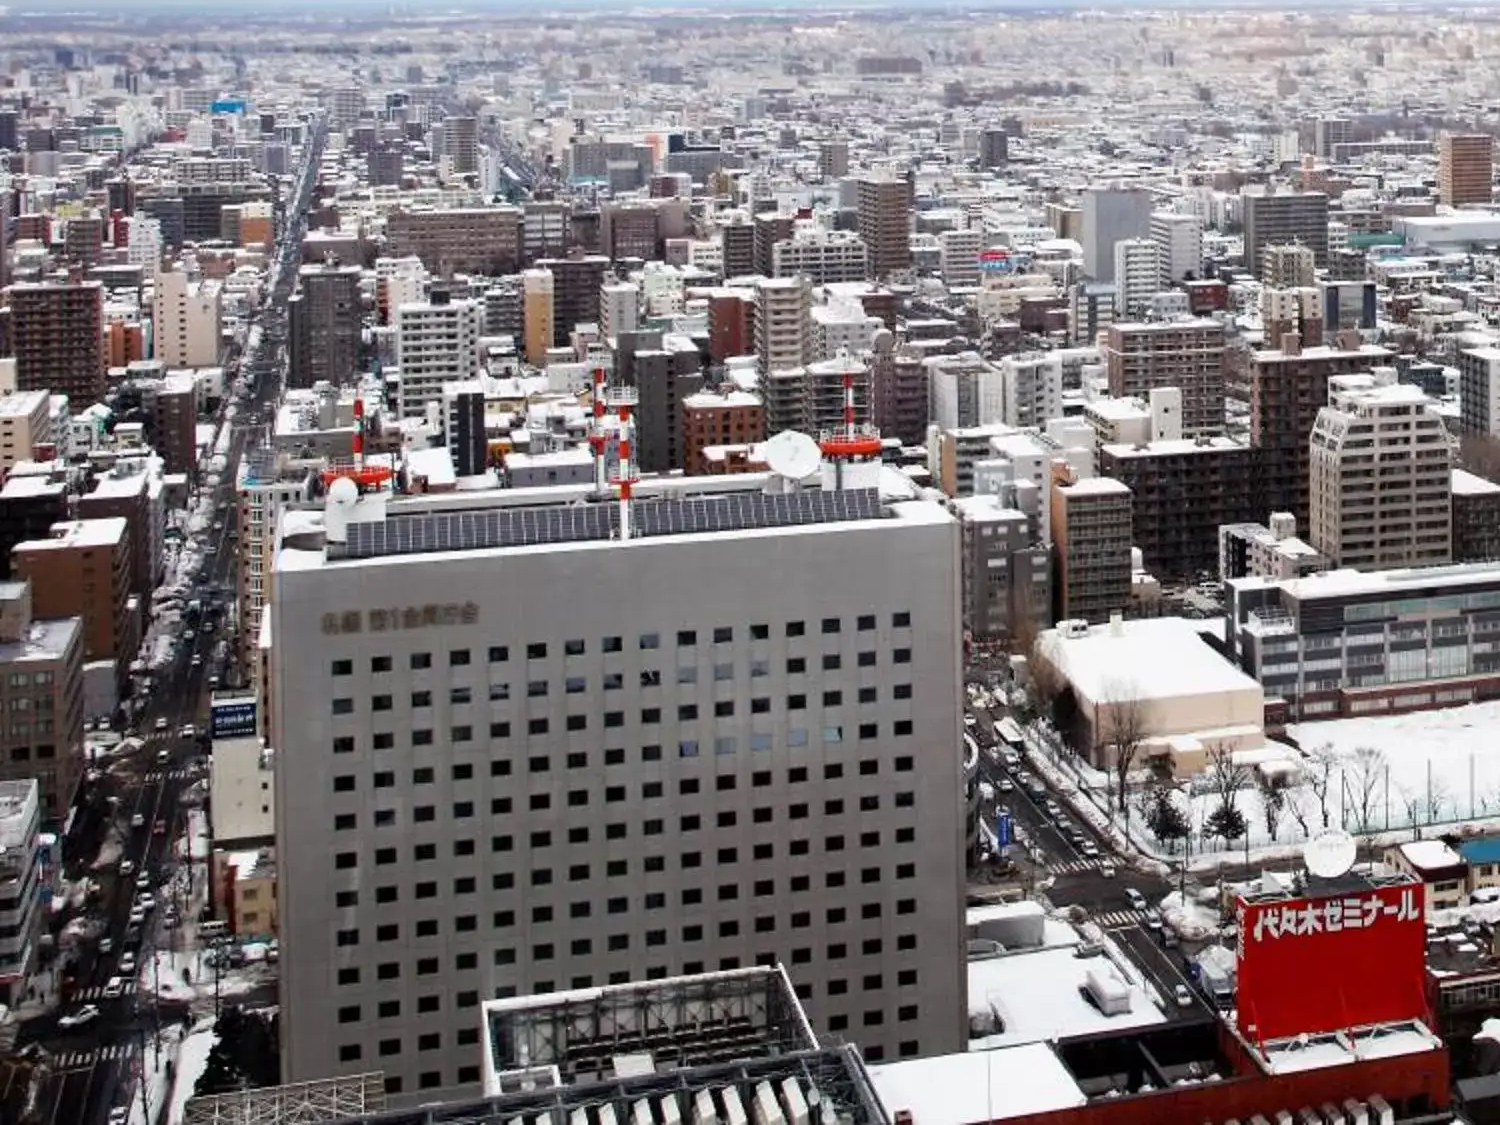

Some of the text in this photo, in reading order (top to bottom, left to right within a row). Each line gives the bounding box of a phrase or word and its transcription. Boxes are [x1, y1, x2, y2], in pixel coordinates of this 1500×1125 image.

[1253, 889, 1420, 942] 代々木ゼミナール
